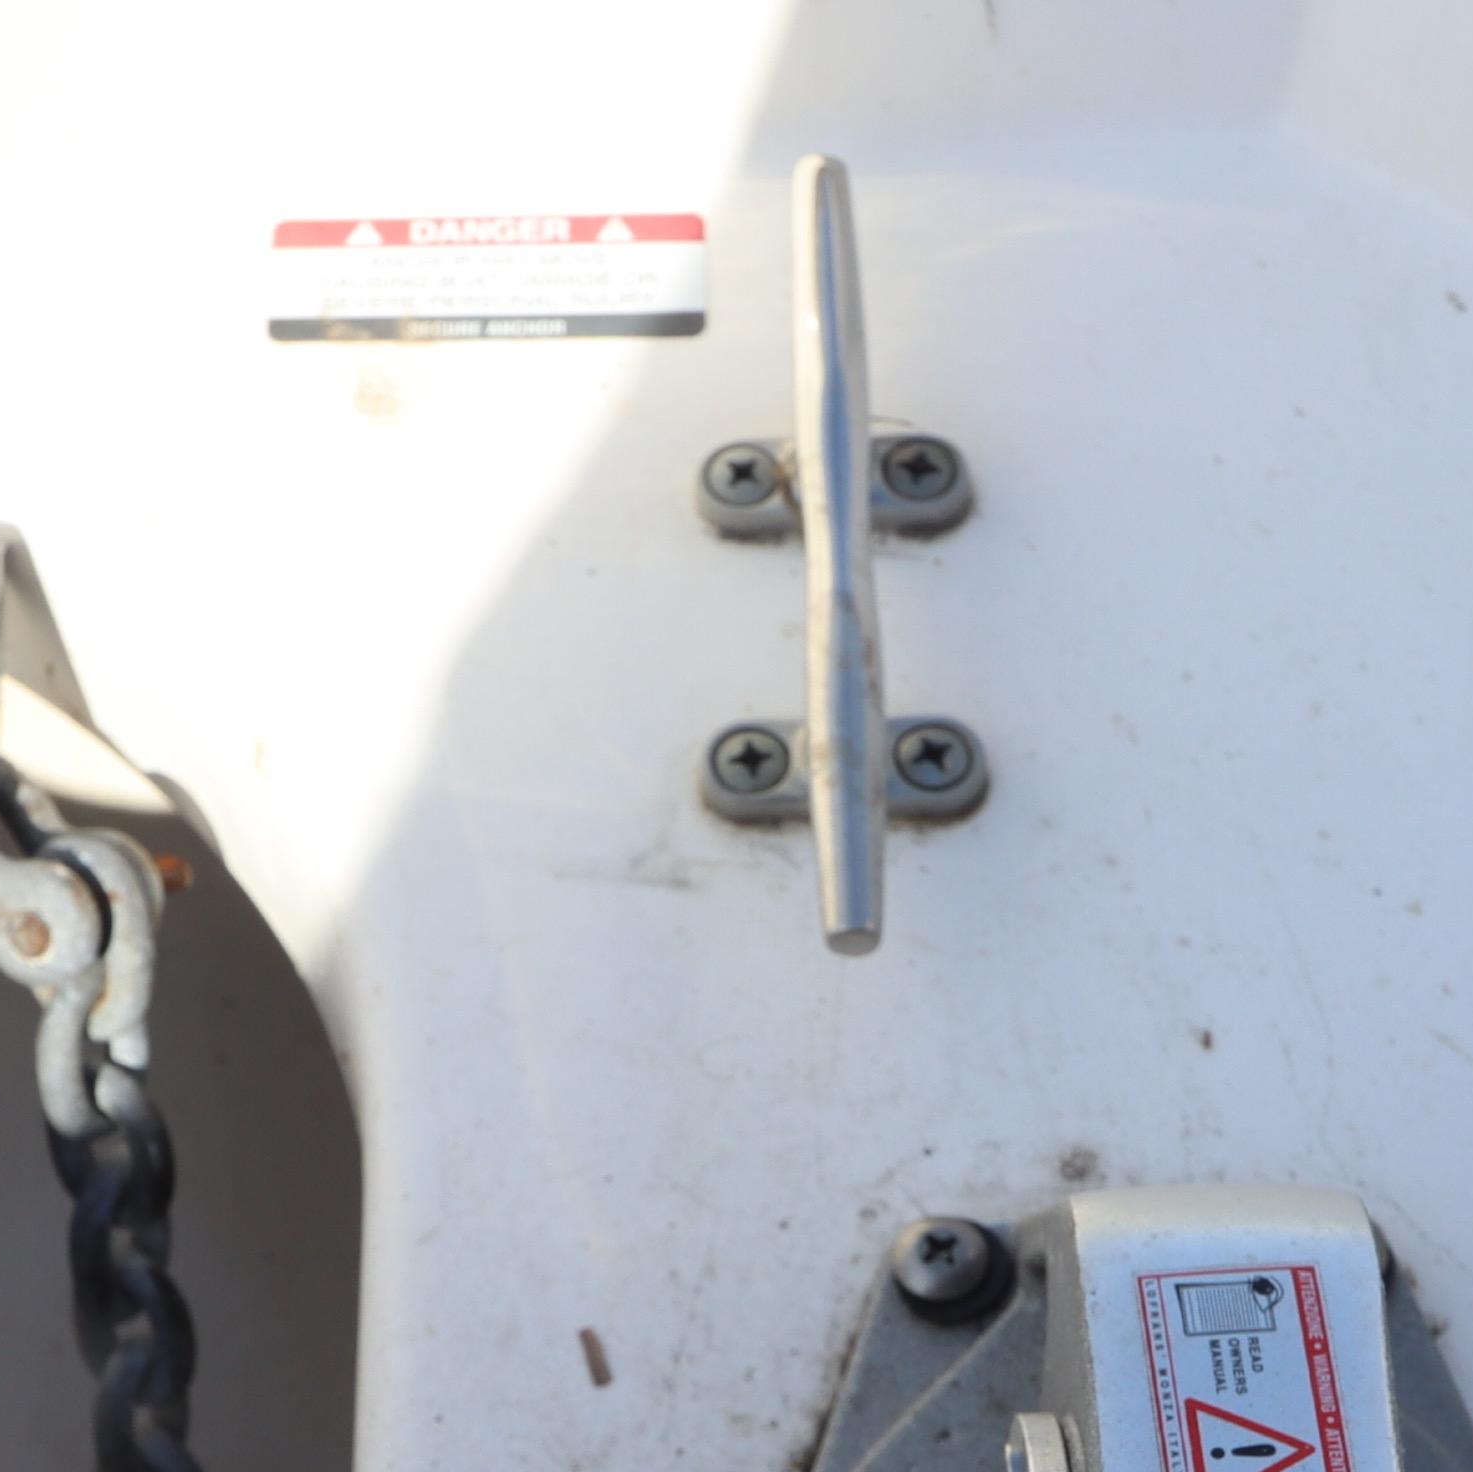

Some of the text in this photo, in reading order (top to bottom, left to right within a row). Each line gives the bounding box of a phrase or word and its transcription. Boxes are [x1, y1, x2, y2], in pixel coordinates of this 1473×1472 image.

[409, 217, 571, 244] DANGER
[485, 318, 567, 336] ANCHOR
[1209, 1339, 1227, 1395] MANUAL
[1228, 1338, 1248, 1396] OWNERS
[1248, 1336, 1264, 1373] READ
[1297, 1271, 1324, 1340] ATTENZIONE
[1313, 1353, 1336, 1413] WARNING
[1159, 1368, 1175, 1422] MONZA
